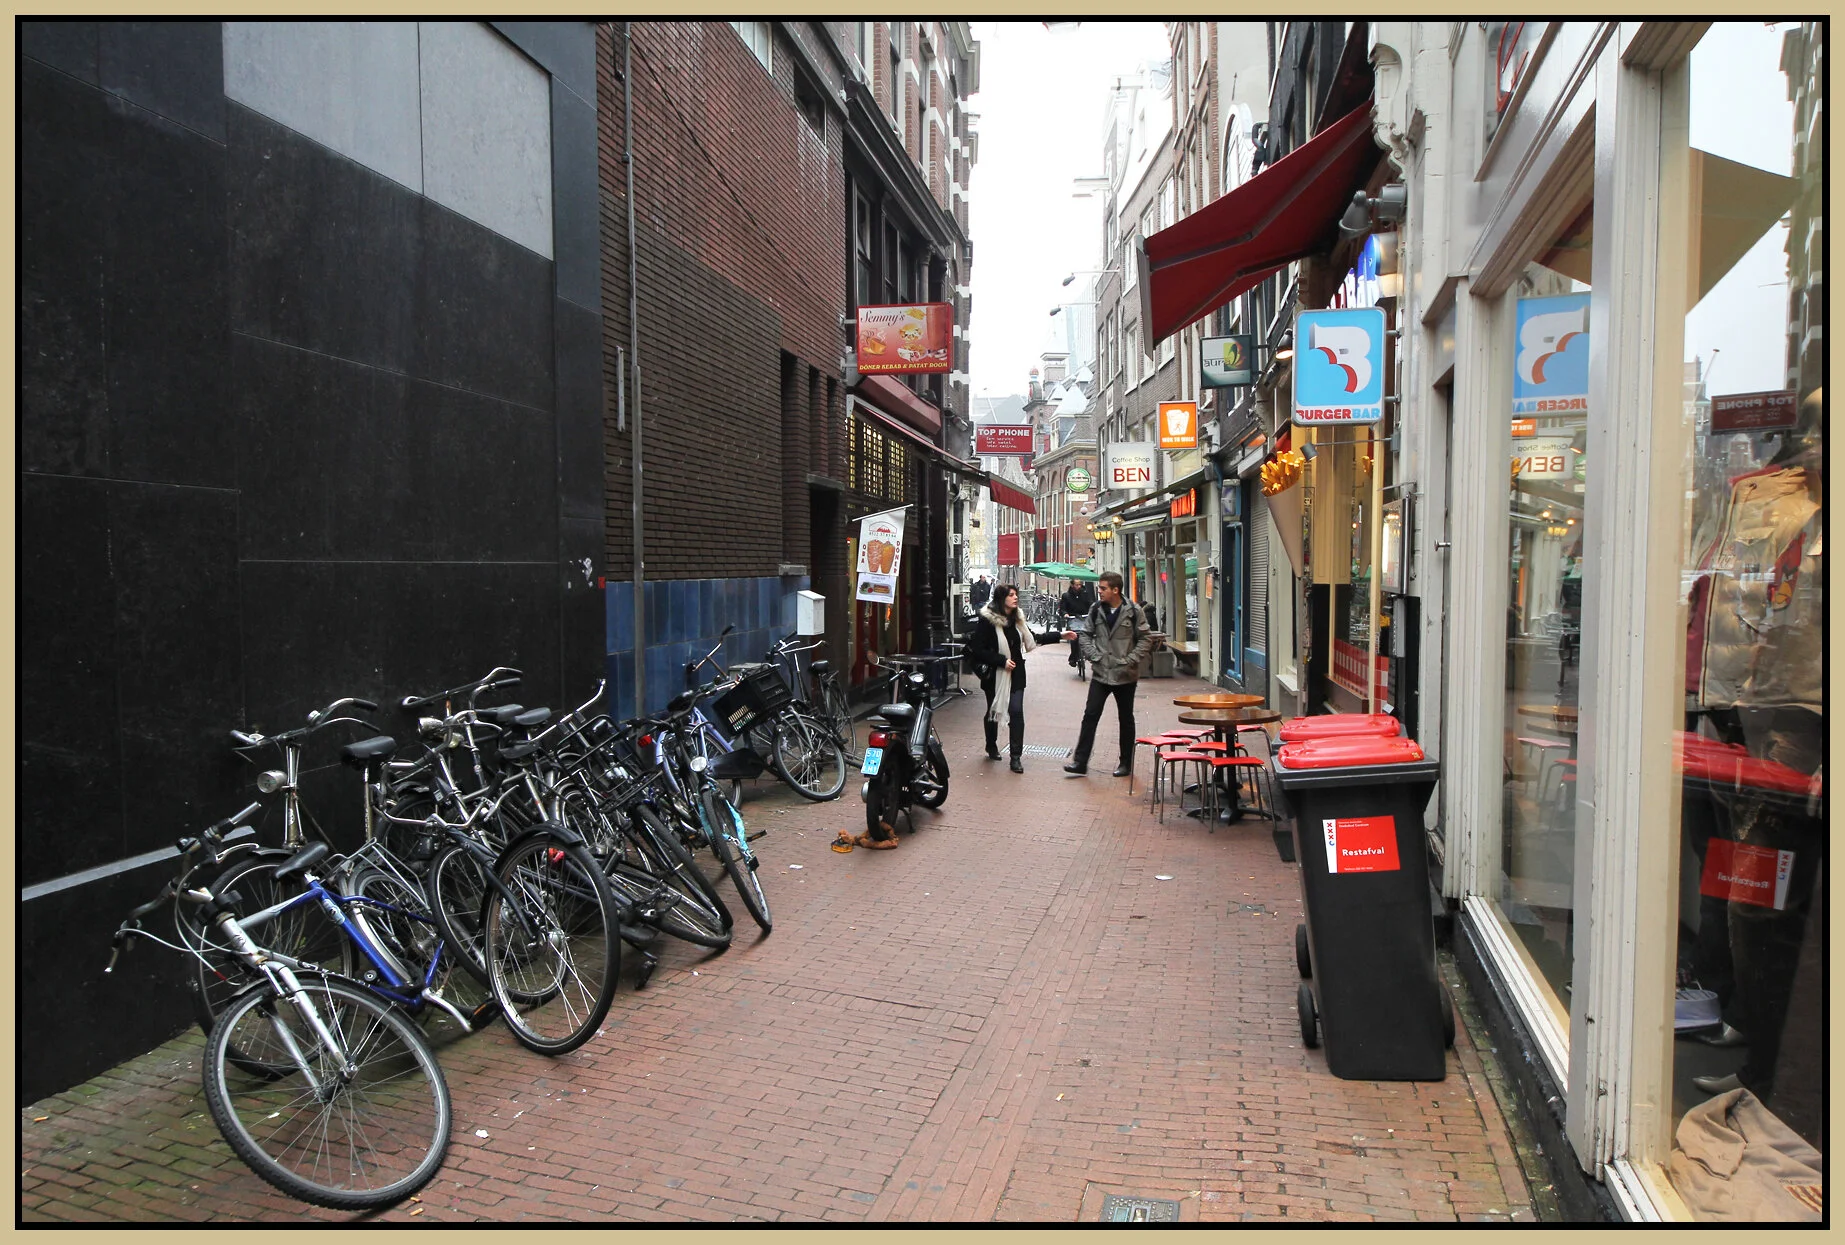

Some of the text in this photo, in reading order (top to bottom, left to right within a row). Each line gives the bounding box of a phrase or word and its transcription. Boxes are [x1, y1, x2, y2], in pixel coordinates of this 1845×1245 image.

[860, 310, 906, 327] Semmy's
[978, 428, 1030, 437] TOP PHONE
[1113, 467, 1150, 482] BEN
[1342, 846, 1385, 857] Restafval
